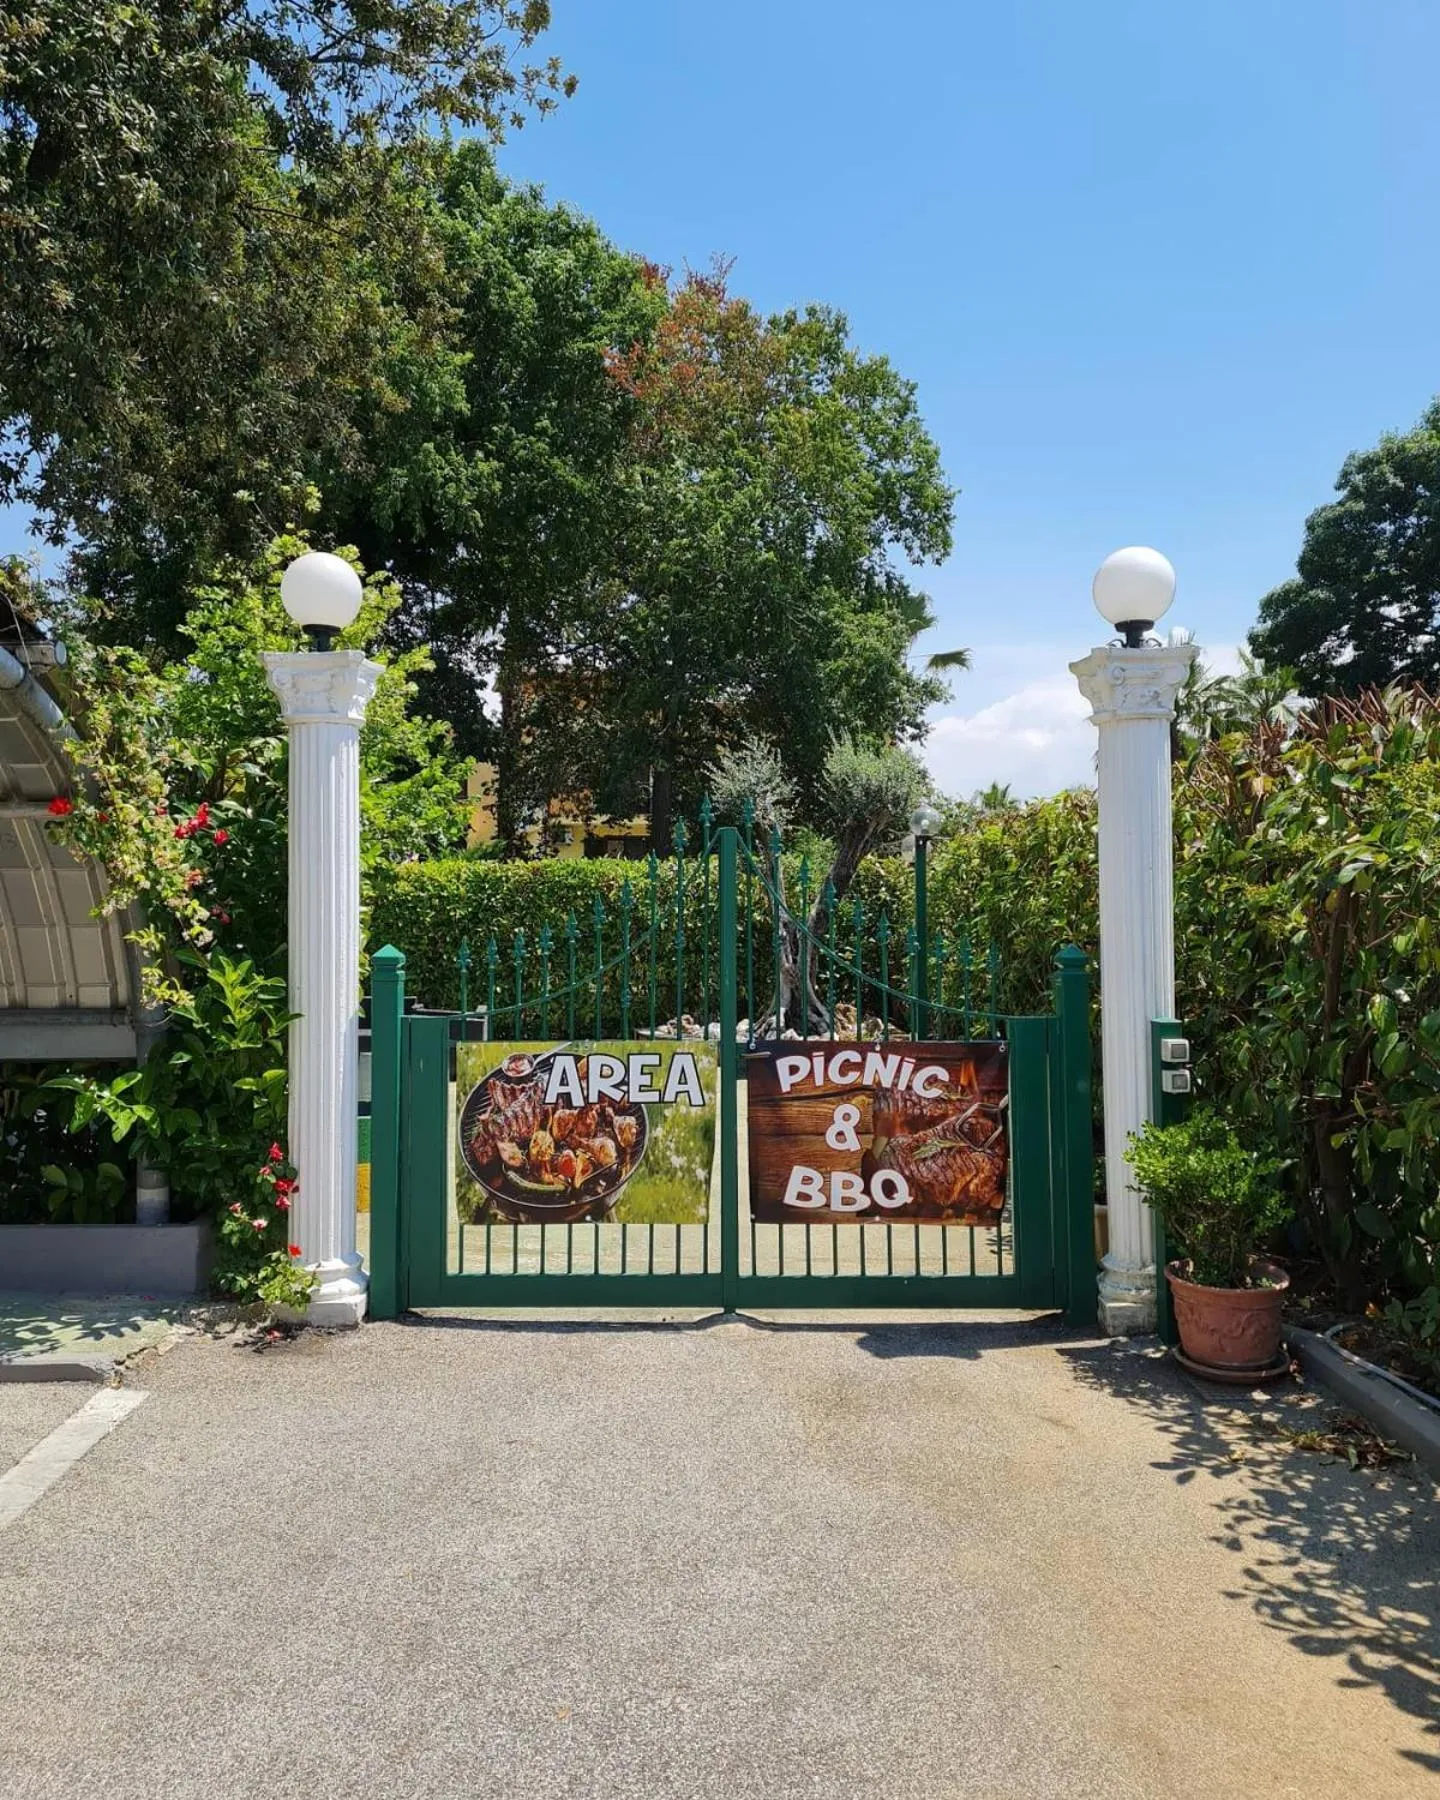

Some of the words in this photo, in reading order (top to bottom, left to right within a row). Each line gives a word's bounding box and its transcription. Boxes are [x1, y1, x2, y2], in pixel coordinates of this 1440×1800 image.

[544, 1053, 705, 1107] AREA
[825, 1103, 861, 1152] &
[783, 1165, 914, 1212] BBQ
